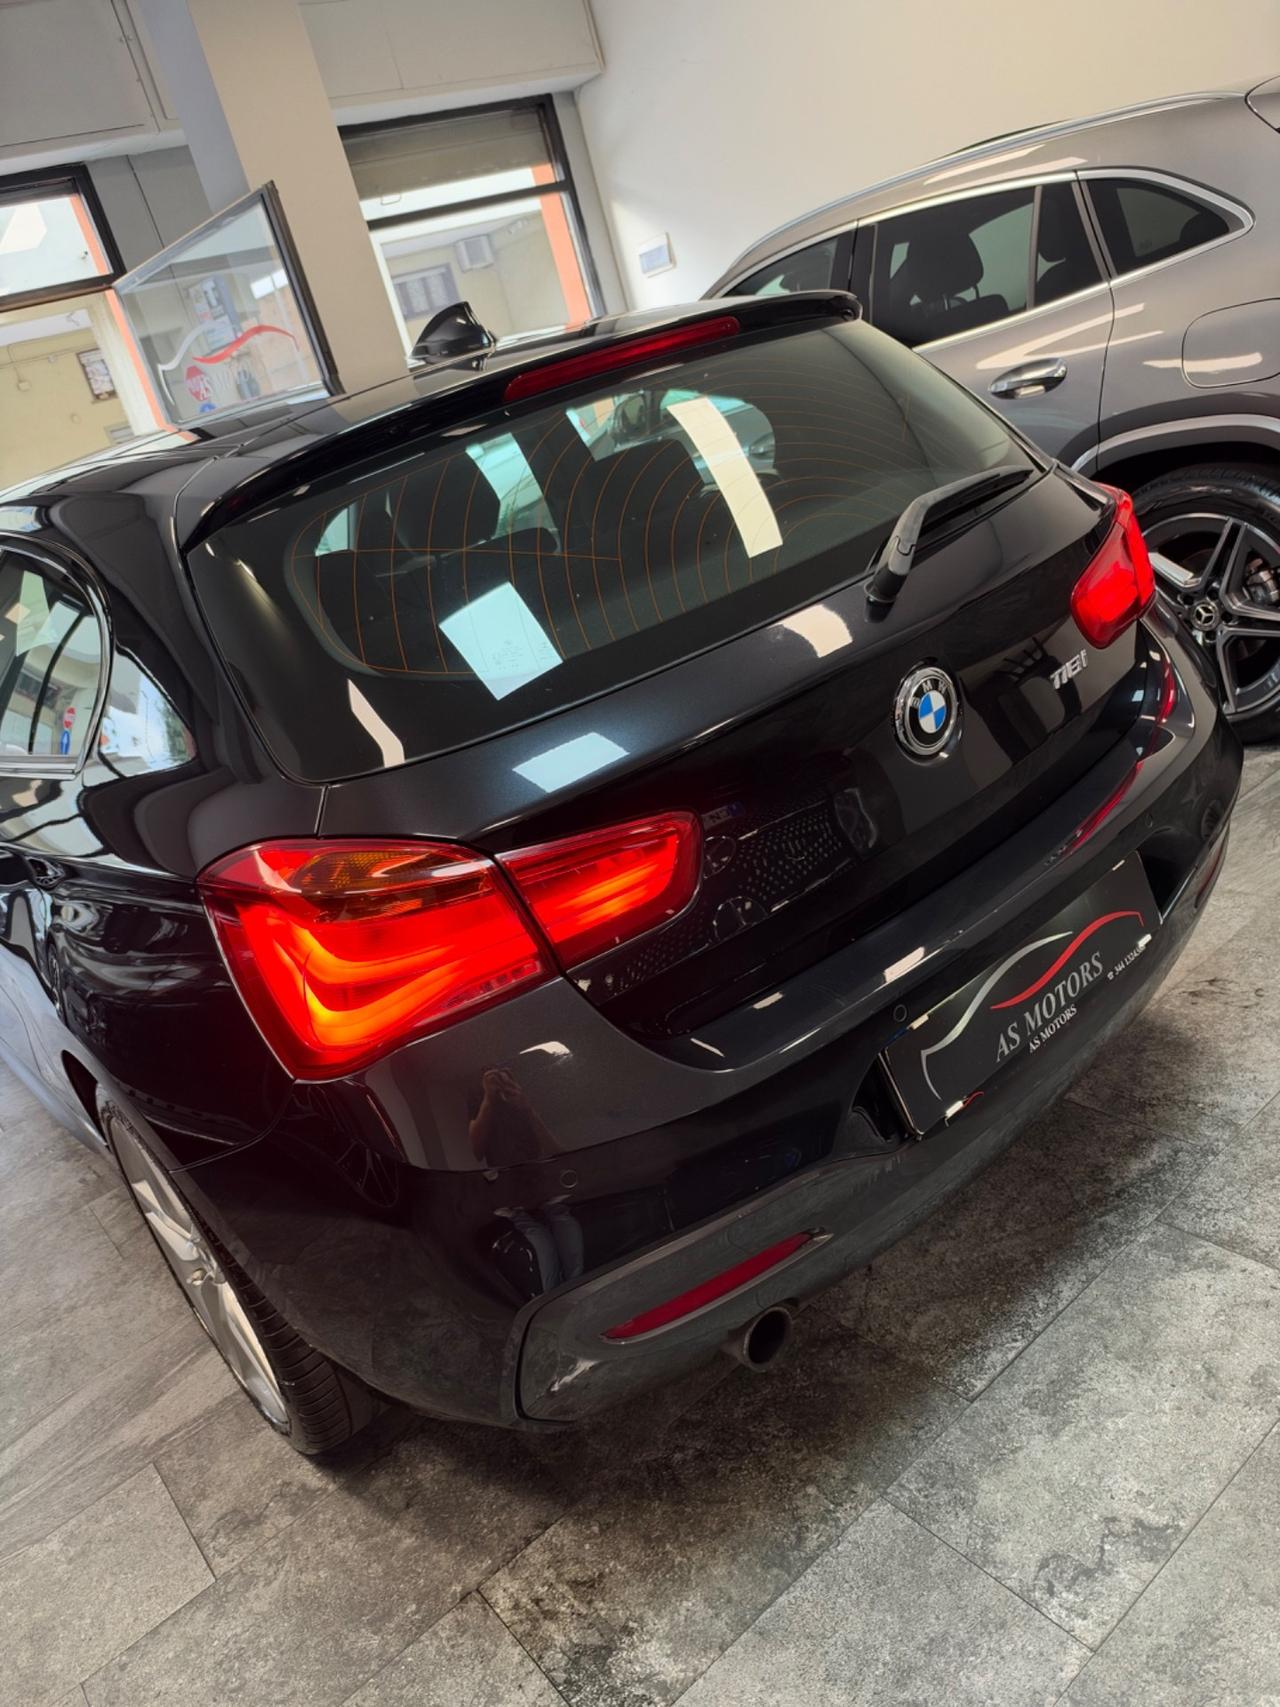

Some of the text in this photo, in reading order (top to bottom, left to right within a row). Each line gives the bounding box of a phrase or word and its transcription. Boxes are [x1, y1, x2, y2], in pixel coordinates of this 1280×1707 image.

[911, 679, 949, 708] BMW
[996, 951, 1103, 1062] AS MOTORS
[1029, 1004, 1078, 1053] AS MOTORS
